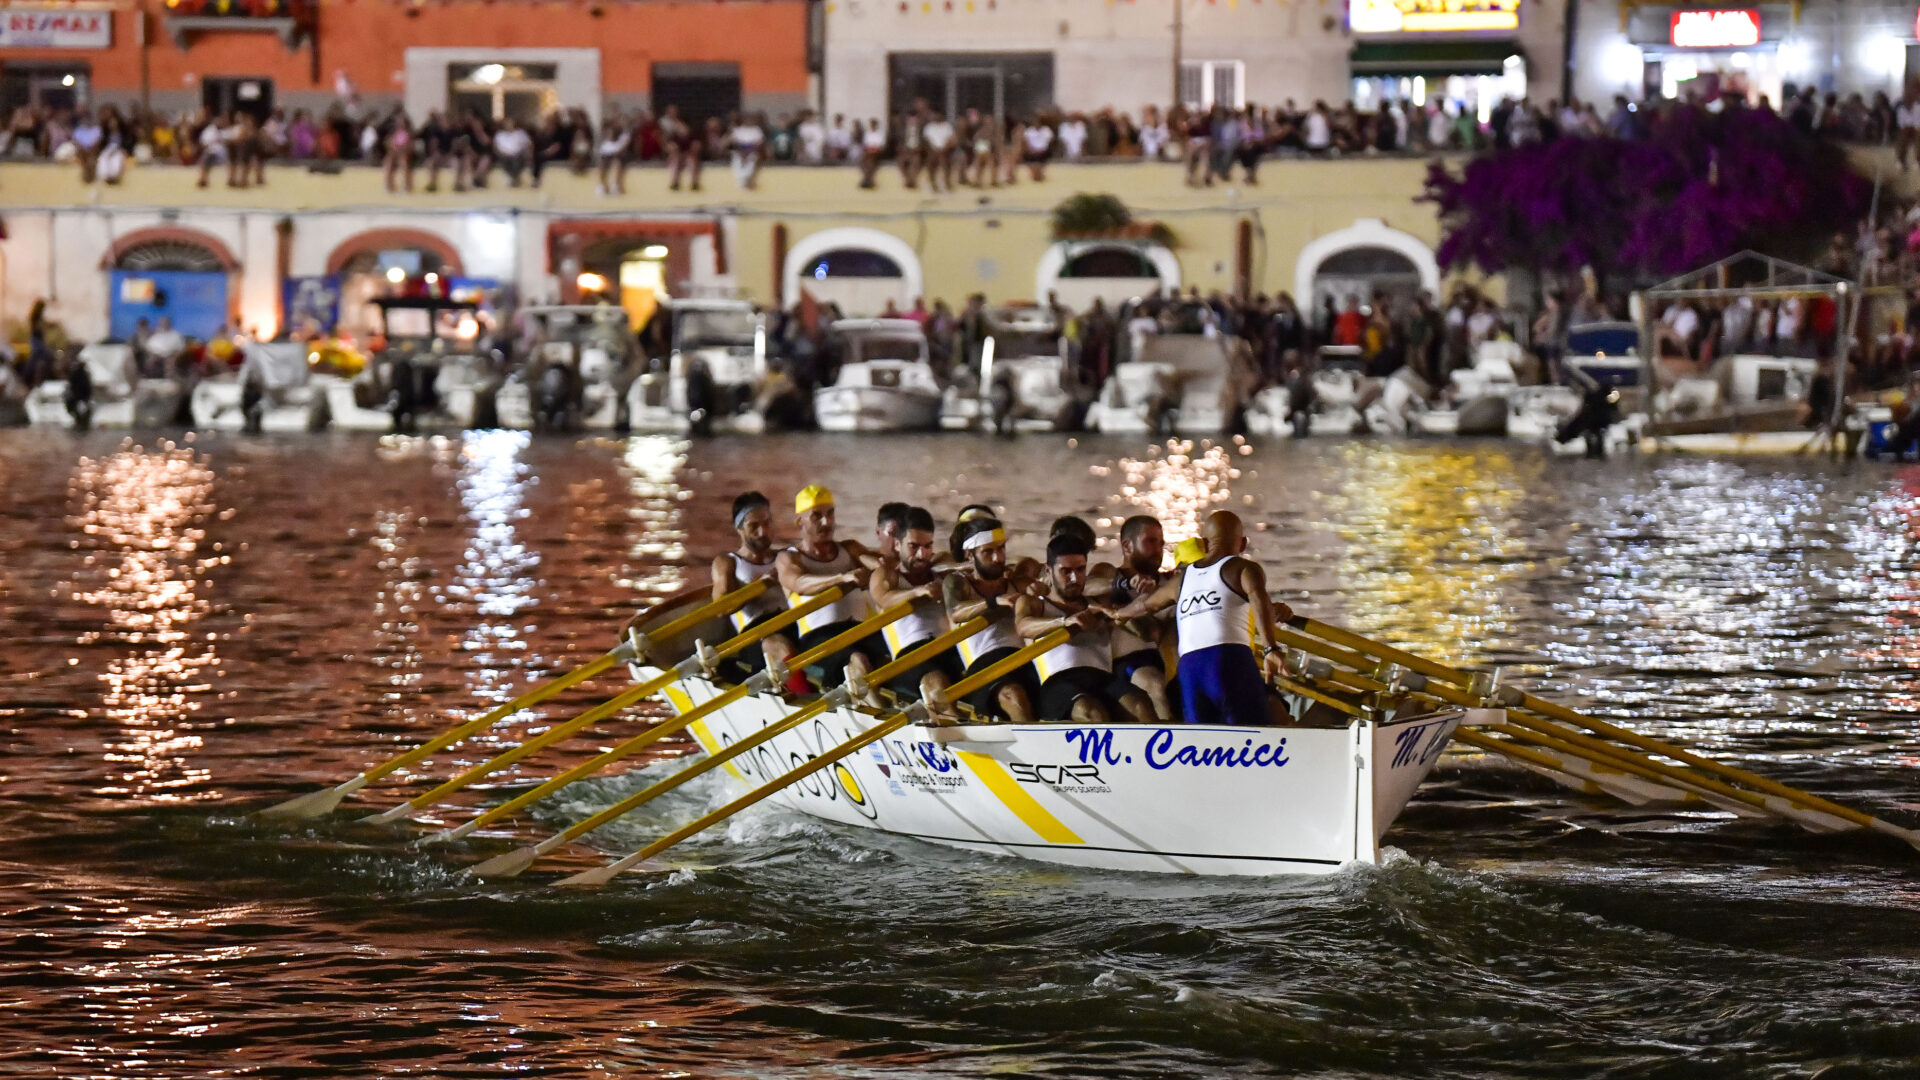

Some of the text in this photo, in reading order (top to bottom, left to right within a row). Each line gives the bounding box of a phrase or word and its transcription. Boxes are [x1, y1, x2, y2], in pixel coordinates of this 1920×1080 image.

[9, 13, 101, 32] RE/MAX
[1180, 590, 1222, 614] CMG
[1065, 728, 1289, 769] M. Camici
[1009, 762, 1106, 784] SCAR
